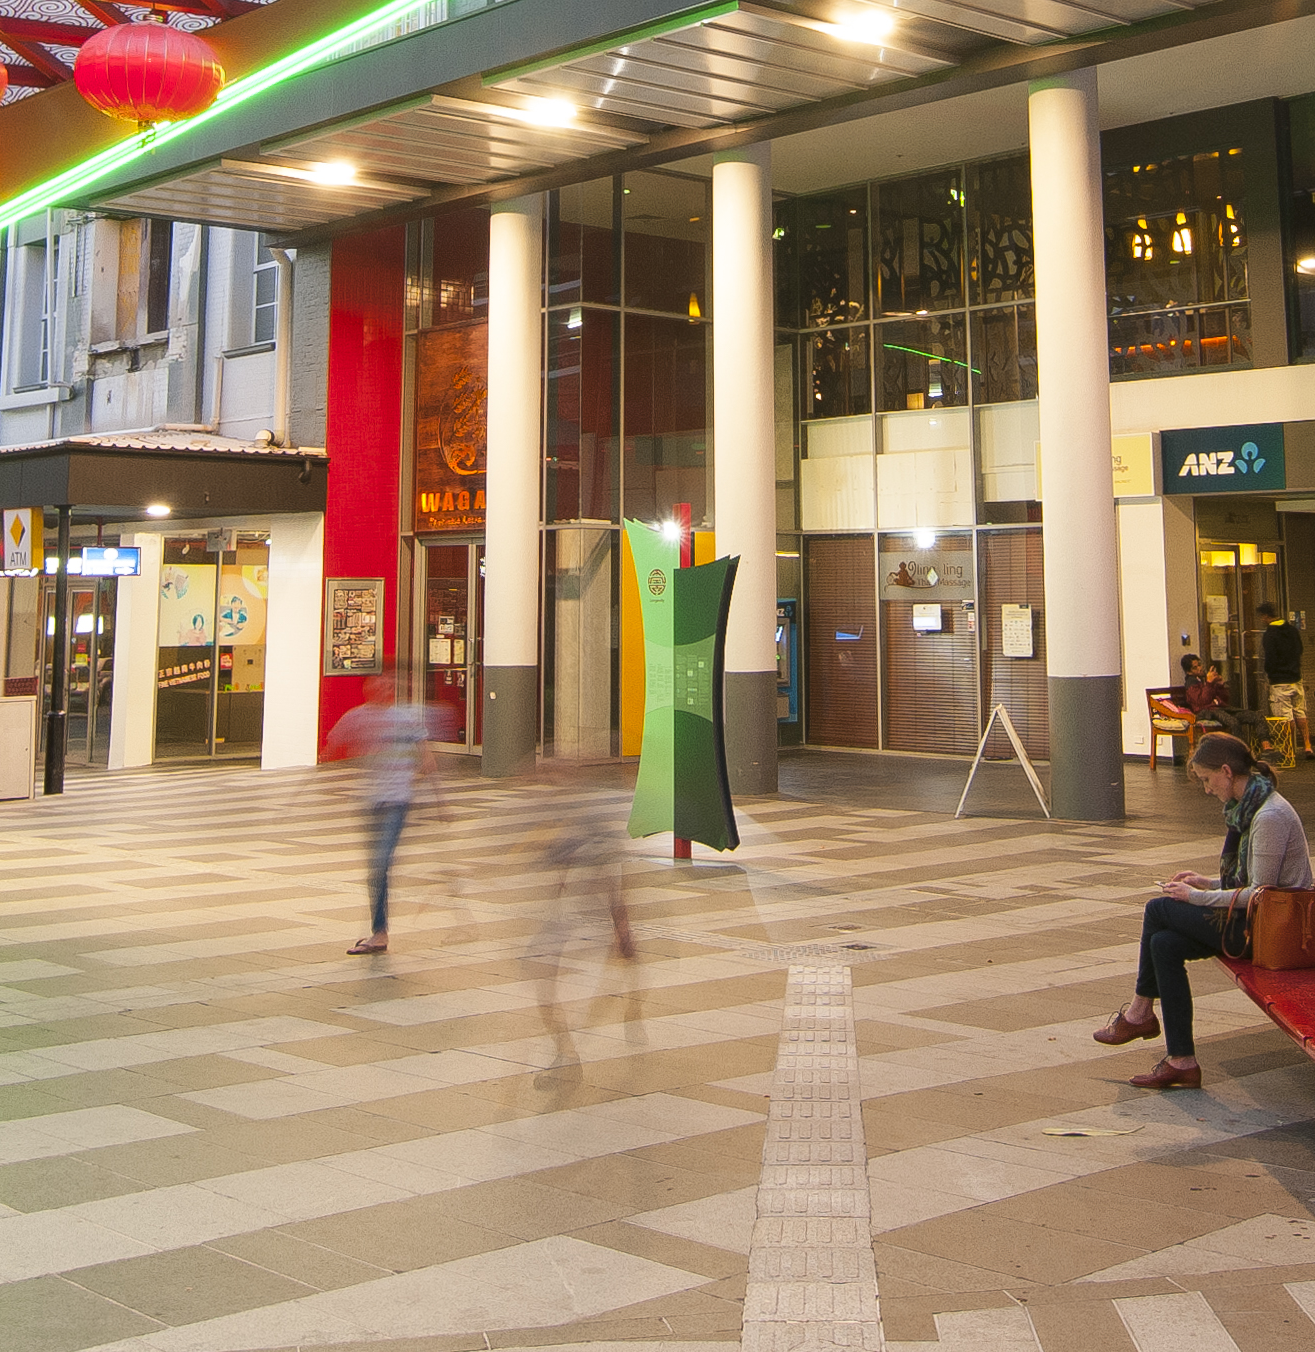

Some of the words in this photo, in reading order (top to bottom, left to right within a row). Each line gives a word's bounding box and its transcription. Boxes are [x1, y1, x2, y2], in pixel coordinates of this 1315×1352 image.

[1178, 451, 1235, 477] ANZ
[421, 490, 486, 513] WAGA
[10, 551, 27, 566] ATM
[943, 562, 963, 578] ling
[938, 578, 971, 588] Massage
[197, 670, 211, 680] FOOD
